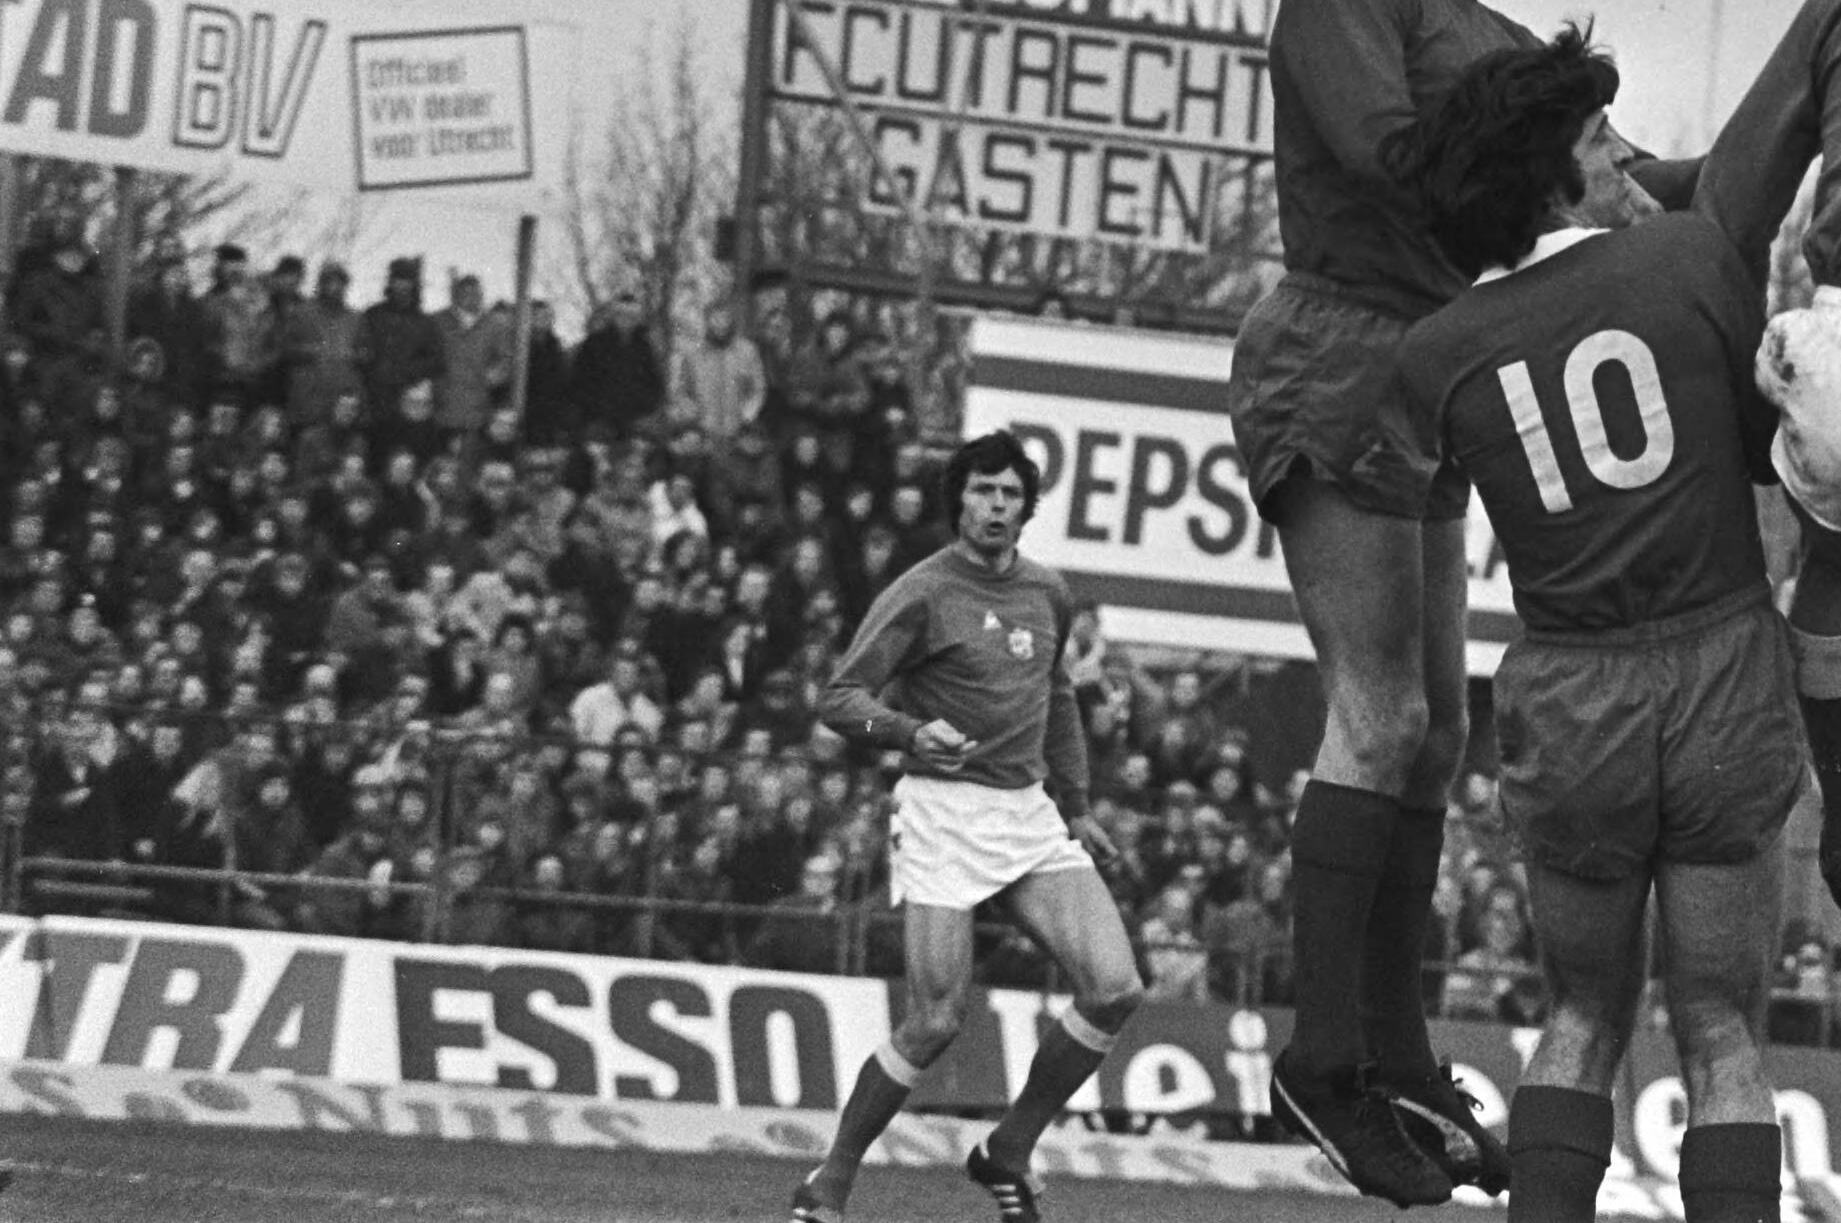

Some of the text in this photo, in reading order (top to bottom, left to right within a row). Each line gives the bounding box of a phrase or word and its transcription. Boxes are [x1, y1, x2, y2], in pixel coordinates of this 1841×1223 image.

[172, 2, 328, 159] BV
[868, 116, 1204, 244] GASTEN
[1497, 329, 1674, 514] 10
[0, 928, 840, 1111] TRA ESSO
